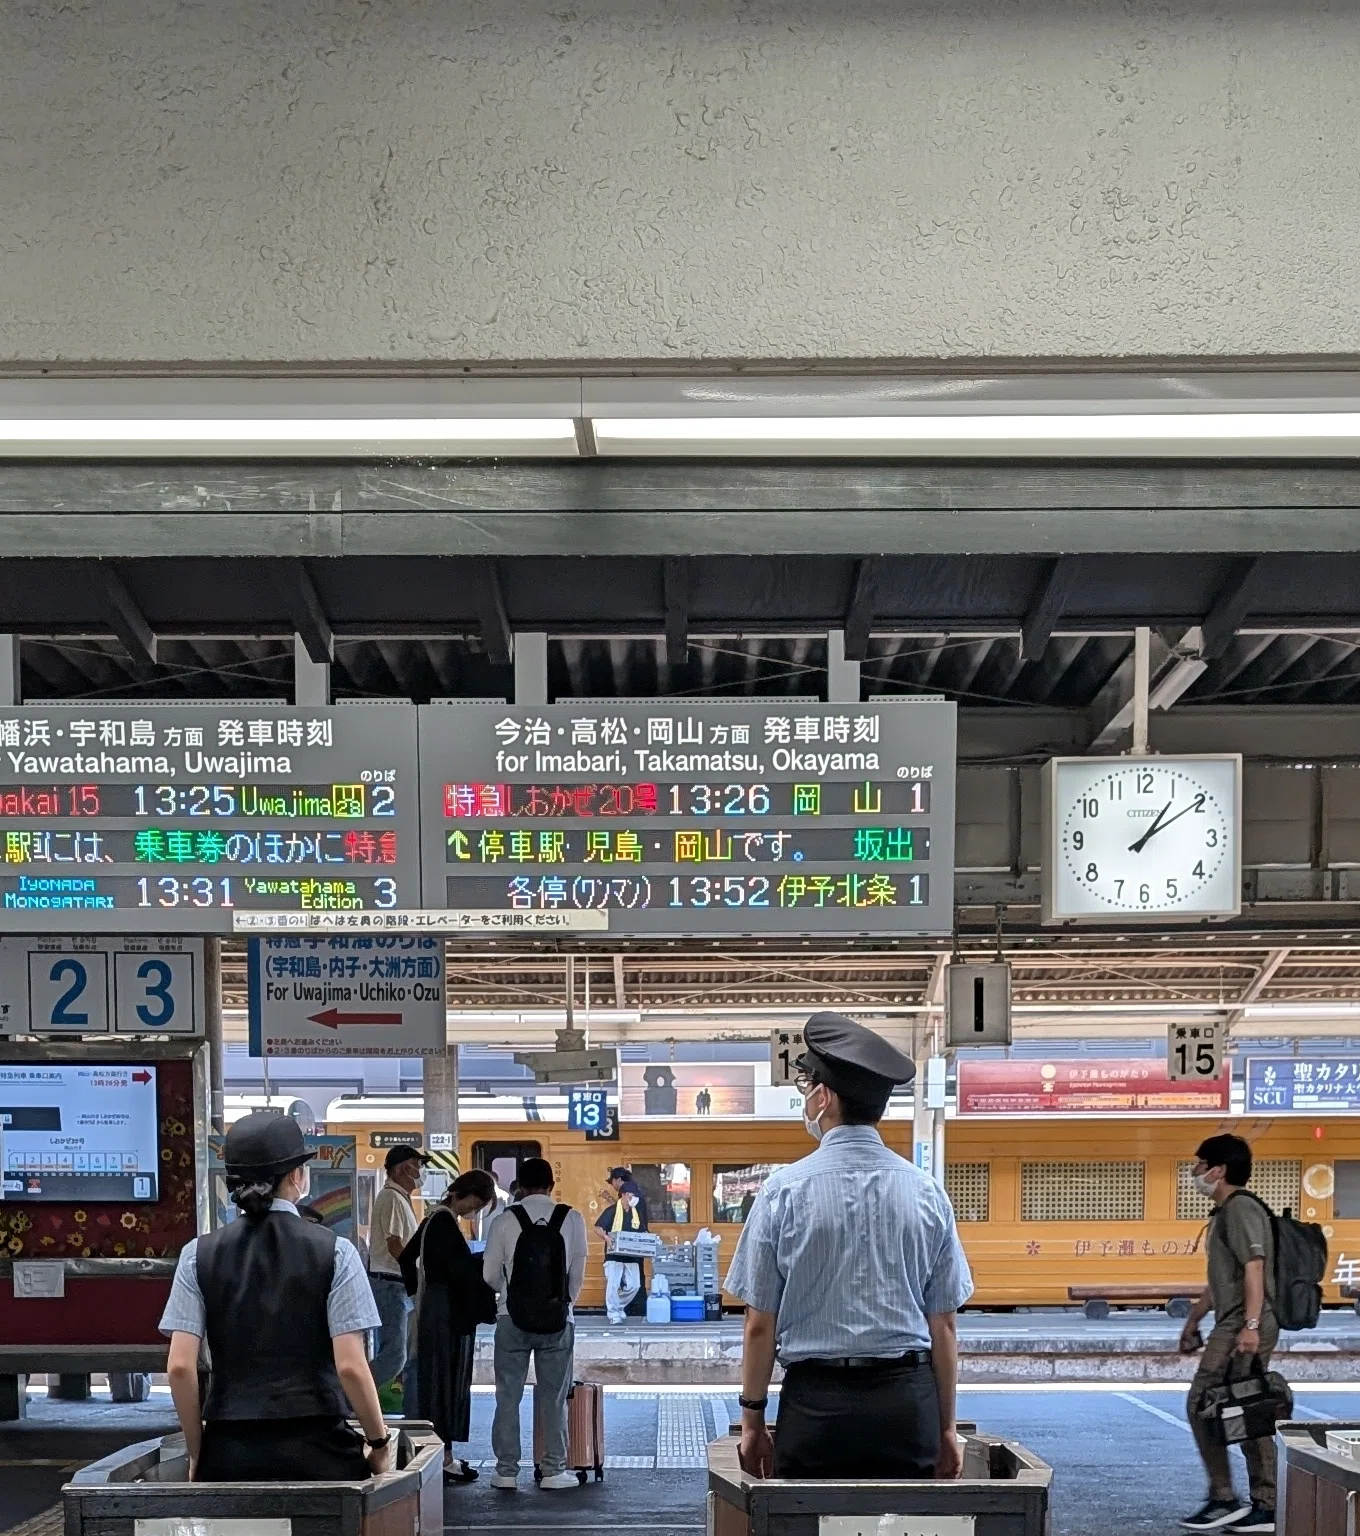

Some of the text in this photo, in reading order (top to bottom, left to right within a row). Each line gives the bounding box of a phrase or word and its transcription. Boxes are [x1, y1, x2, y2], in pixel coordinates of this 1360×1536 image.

[164, 727, 203, 746] 方面
[217, 719, 333, 747] 発車時刻
[495, 715, 879, 745] 今治・高松・岡山 方面 発車時刻
[7, 752, 175, 776] Yawatahama,
[185, 752, 292, 778] Uwajima
[496, 749, 880, 775] for Imabari, Takamatsu, Okayama
[897, 766, 933, 778] のりば
[360, 769, 396, 782] のりば
[1137, 773, 1154, 794] 12
[68, 785, 101, 815] 15
[134, 785, 236, 816] 13:25
[241, 786, 332, 817] Uwajima
[372, 786, 396, 816] 2
[447, 784, 504, 816] 特急
[669, 784, 770, 815] 13:26
[910, 782, 925, 813] 1
[1110, 780, 1122, 801] 11
[1083, 798, 1099, 818] 10
[1194, 793, 1206, 813] 2
[478, 830, 565, 863] 停車駅
[1072, 830, 1084, 850] 9
[1205, 828, 1218, 848] 3
[1085, 862, 1099, 882] 8
[1192, 859, 1205, 880] 4
[138, 877, 234, 907] 13:31
[244, 879, 356, 893] Yawatahama
[373, 878, 397, 908] 3
[669, 876, 770, 906] 13:52
[777, 873, 897, 907] 伊予北条
[909, 875, 924, 905] 1
[1114, 879, 1125, 899] 7
[1139, 883, 1150, 903] 6
[1166, 878, 1178, 898] 5
[301, 893, 363, 909] Edition
[49, 959, 88, 1025] 2
[136, 960, 175, 1026] 3
[267, 982, 289, 1001] For
[1175, 1027, 1214, 1039] 乗車口
[1175, 1044, 1215, 1075] 15
[1253, 1091, 1287, 1105] SCU
[574, 1103, 600, 1126] 13
